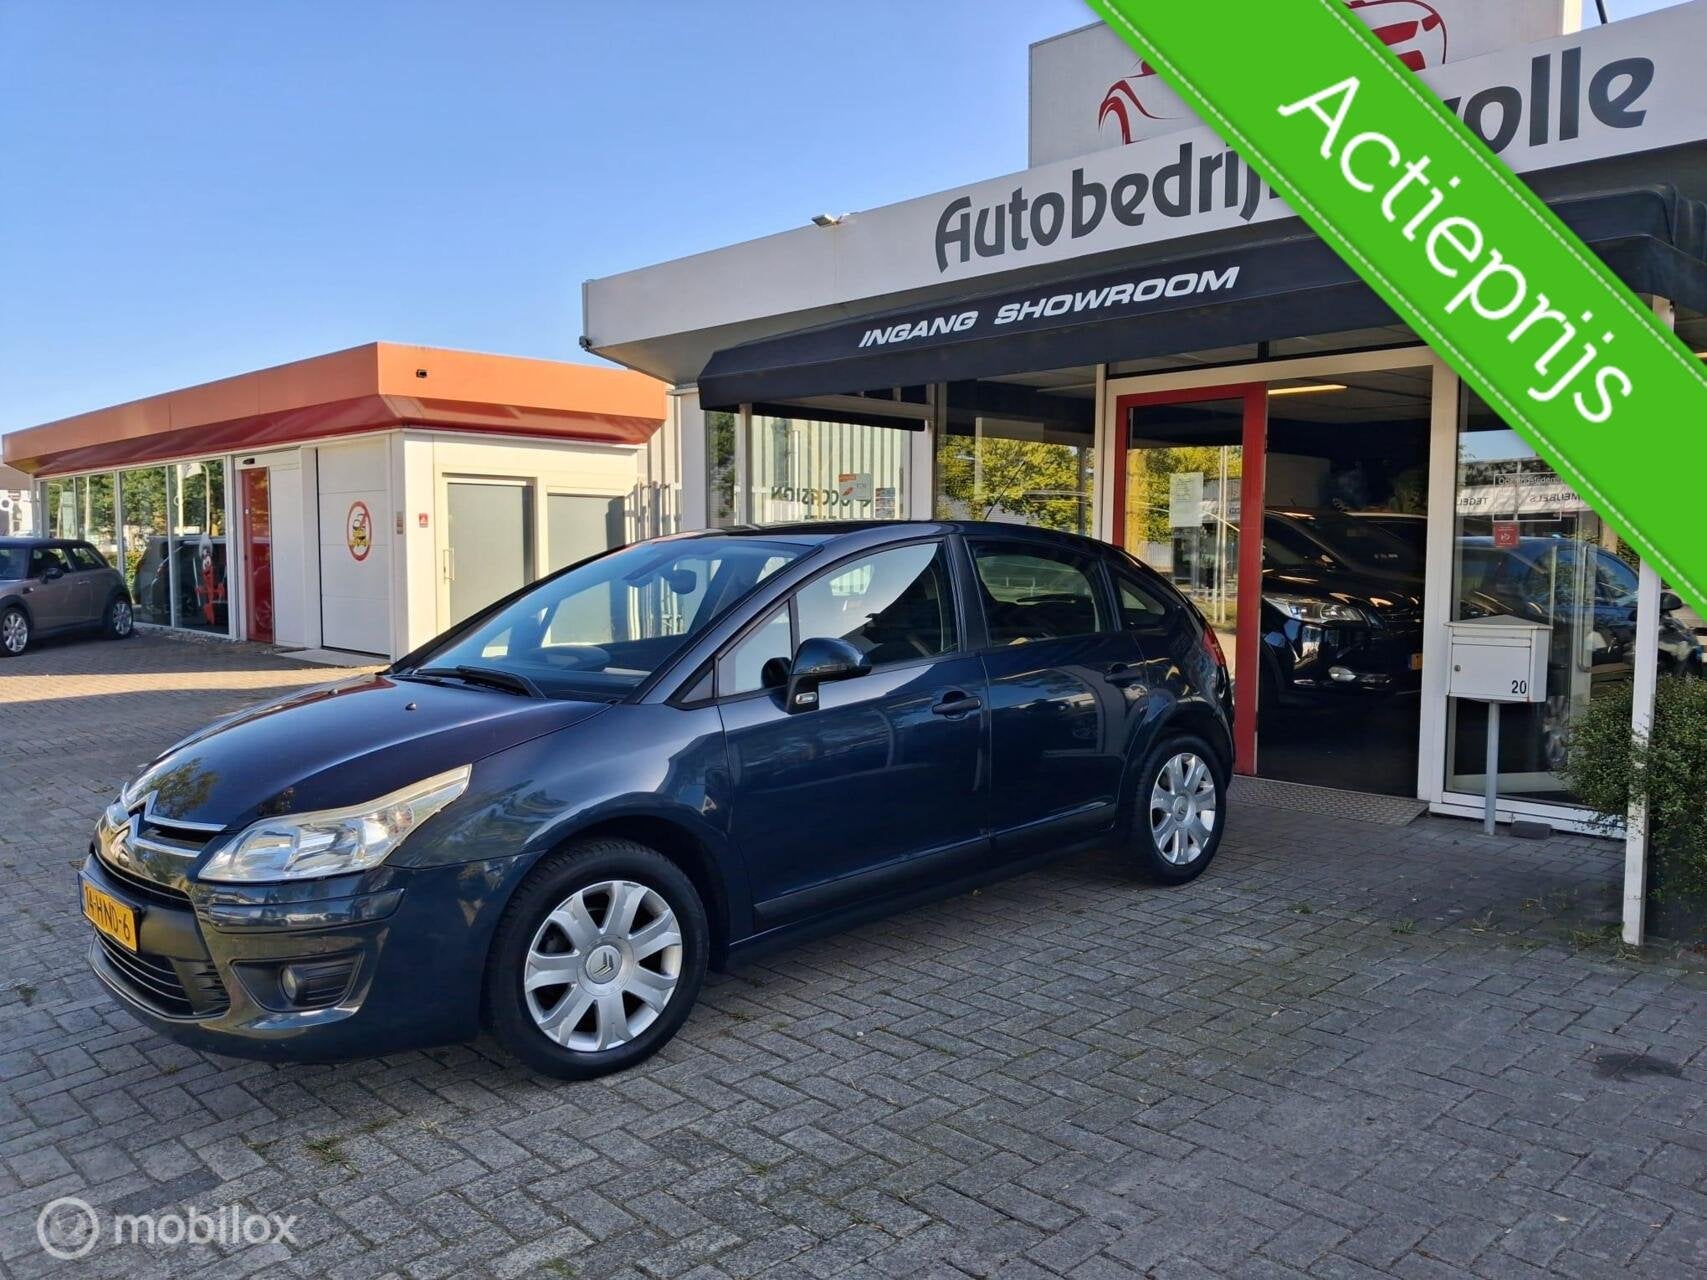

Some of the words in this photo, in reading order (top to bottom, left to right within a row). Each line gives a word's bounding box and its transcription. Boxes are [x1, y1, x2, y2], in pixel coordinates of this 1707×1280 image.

[935, 141, 1280, 273] Autobedrij
[858, 310, 979, 348] INGANG
[994, 266, 1240, 325] SHOWROOM
[1511, 679, 1527, 694] 20
